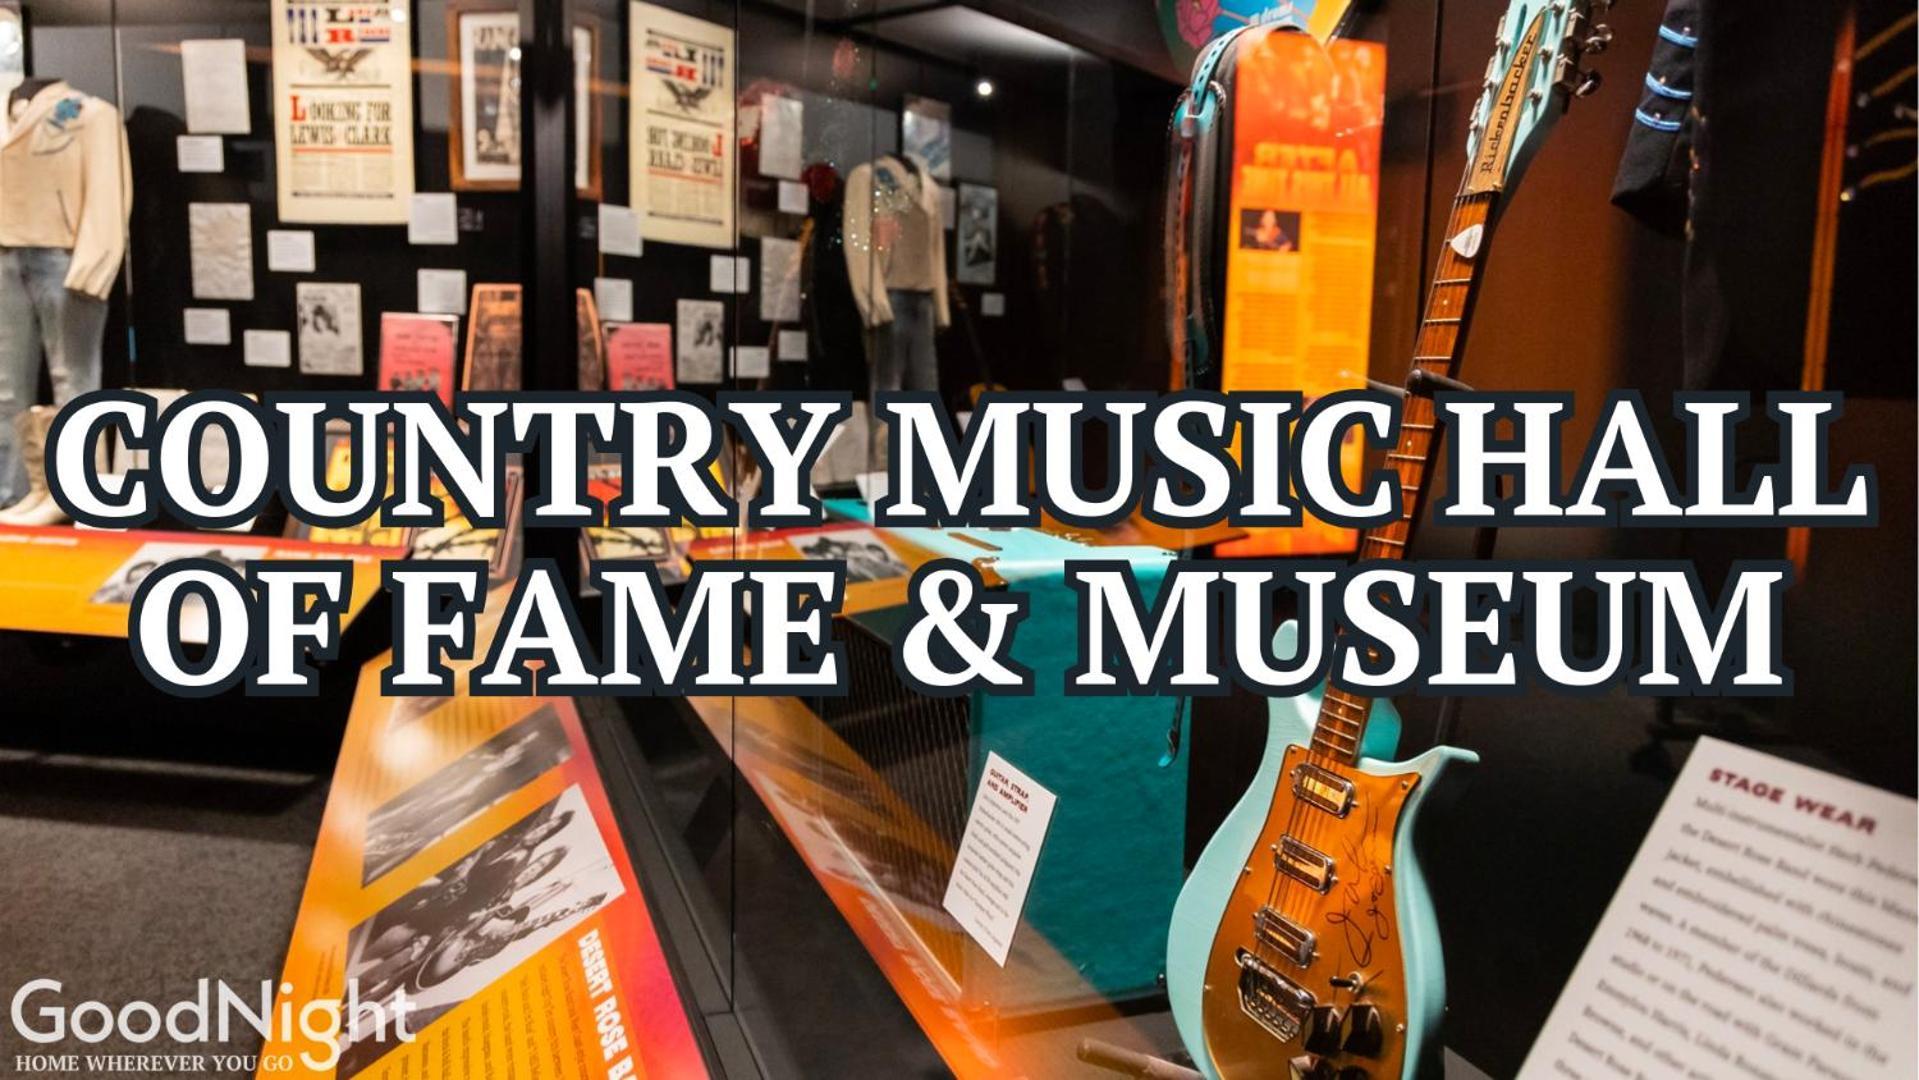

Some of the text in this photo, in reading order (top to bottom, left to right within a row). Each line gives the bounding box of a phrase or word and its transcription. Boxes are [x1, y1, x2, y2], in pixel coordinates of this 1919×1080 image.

[344, 126, 390, 145] CLARK
[1480, 33, 1537, 174] Rickenbacker
[1709, 767, 1878, 835] STAGE WEAR
[577, 927, 613, 1000] DESERT
[593, 995, 629, 1062] ROSE
